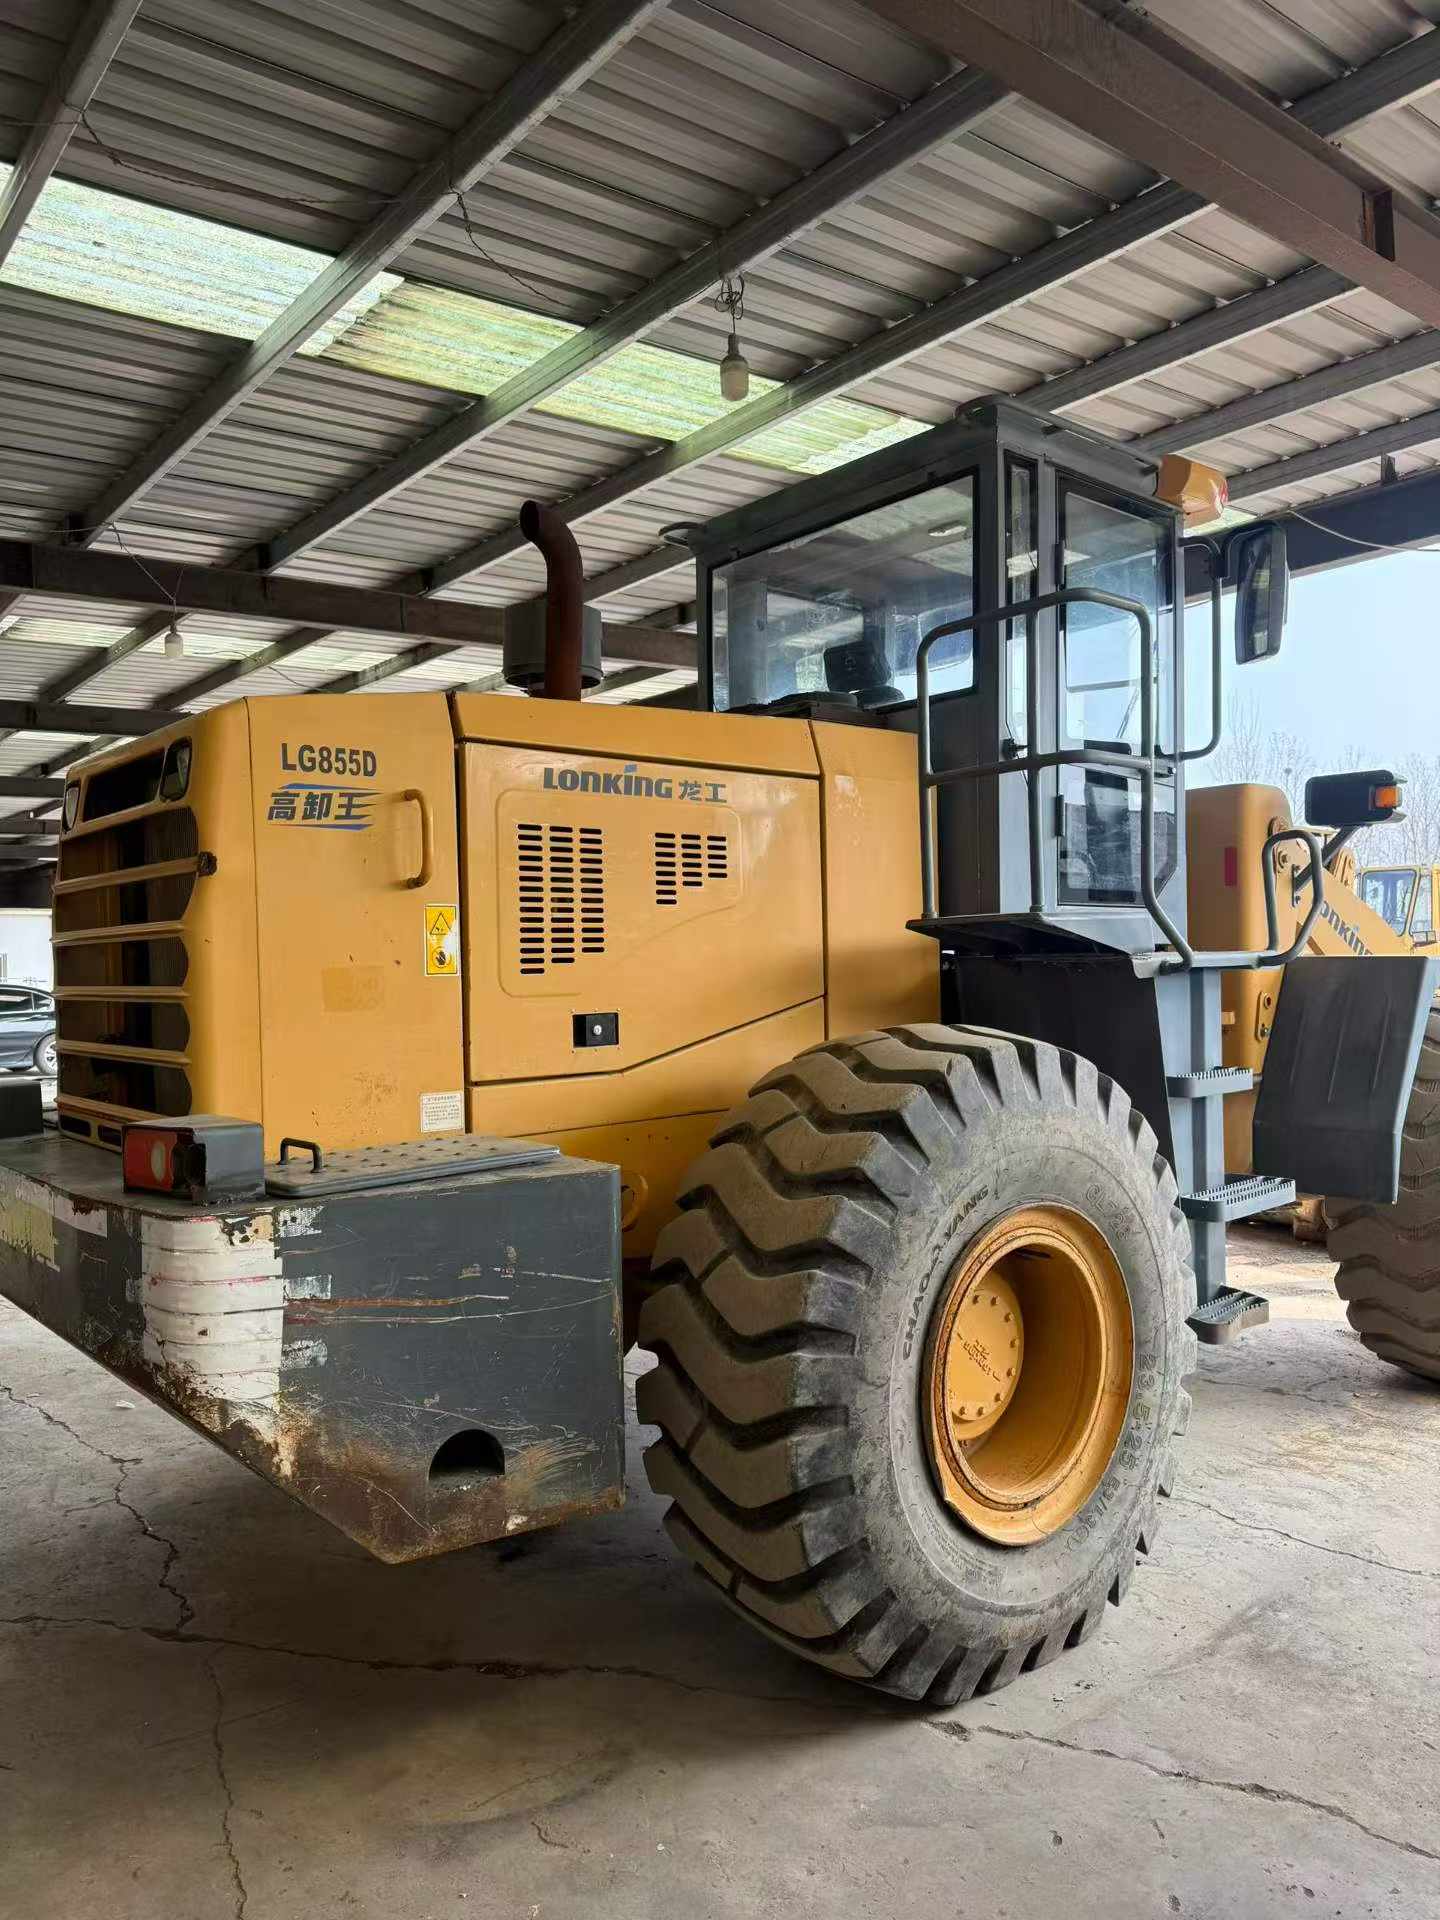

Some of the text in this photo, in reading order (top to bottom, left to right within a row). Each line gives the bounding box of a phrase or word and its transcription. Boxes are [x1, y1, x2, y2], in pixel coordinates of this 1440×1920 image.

[281, 742, 377, 777] LG855D
[267, 791, 384, 821] 高卸王
[678, 779, 728, 804] 龙工
[1319, 900, 1373, 957] ONKIN
